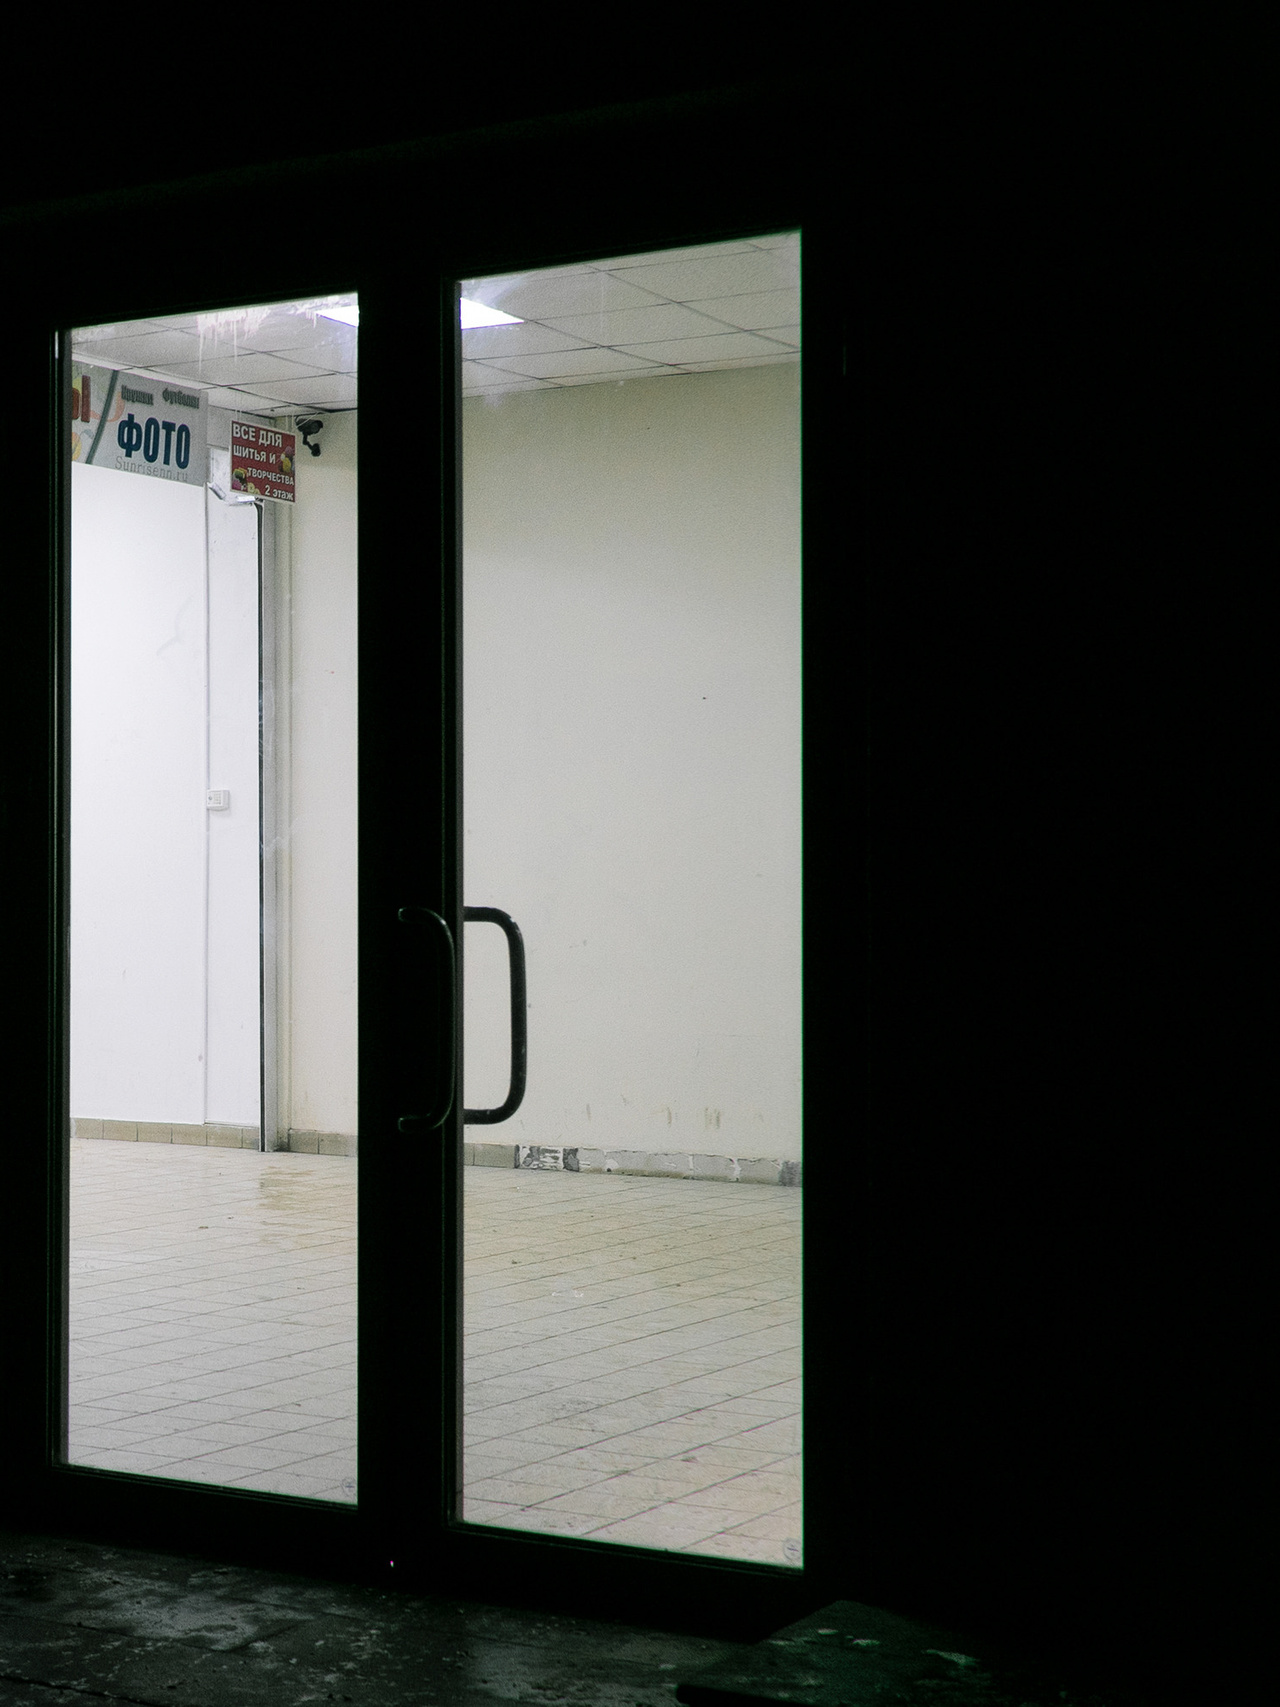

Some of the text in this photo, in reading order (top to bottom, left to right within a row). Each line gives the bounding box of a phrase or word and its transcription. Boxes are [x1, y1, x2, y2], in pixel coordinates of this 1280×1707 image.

[117, 412, 191, 470] ФОТО
[232, 423, 282, 448] ВСЕ ДЛЯ
[233, 444, 276, 465] ШИТЬЯ И
[247, 467, 295, 486] ТВОРЧЕСТВА
[264, 484, 294, 501] 2 этаж
